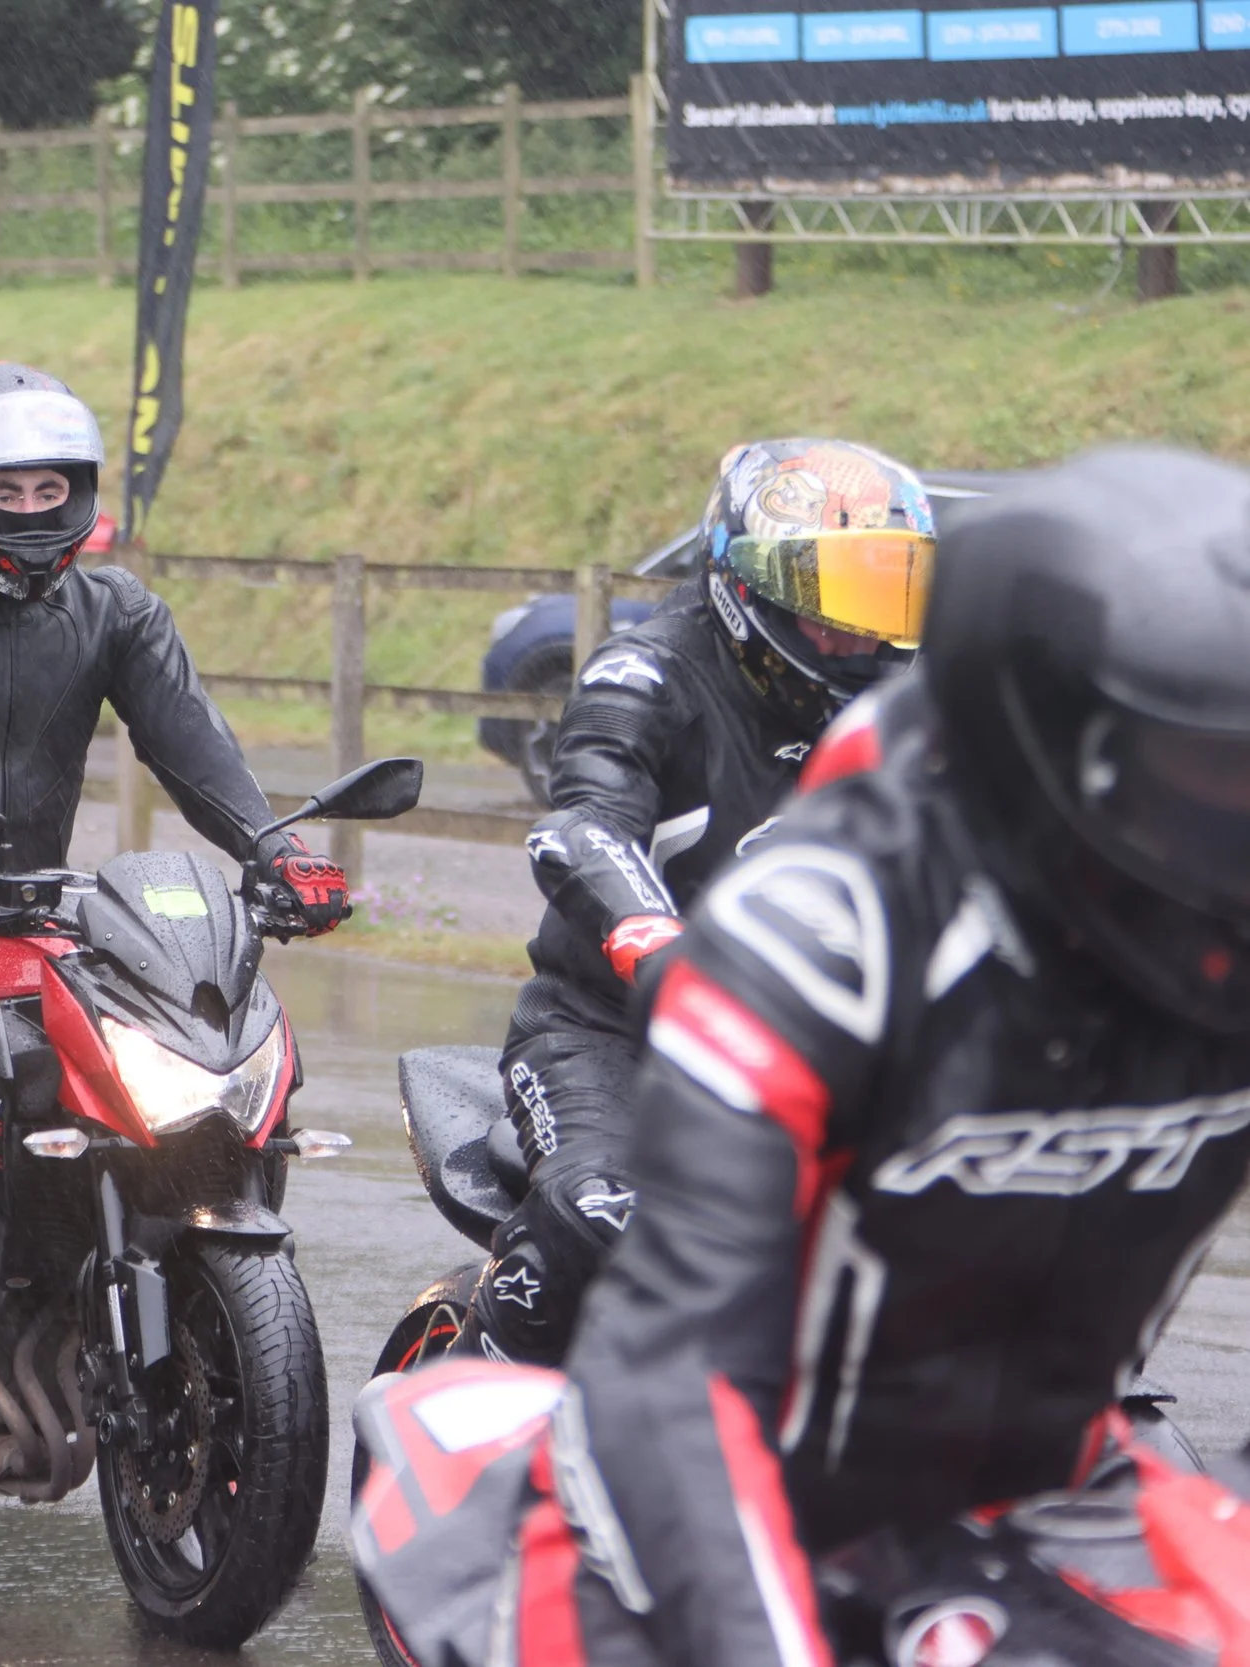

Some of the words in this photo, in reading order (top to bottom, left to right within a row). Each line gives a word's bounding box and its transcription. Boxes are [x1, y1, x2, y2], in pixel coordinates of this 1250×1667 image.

[1096, 91, 1184, 125] experience
[1184, 89, 1227, 123] days,
[713, 581, 741, 631] SHOEI
[870, 1087, 1250, 1195] RST
